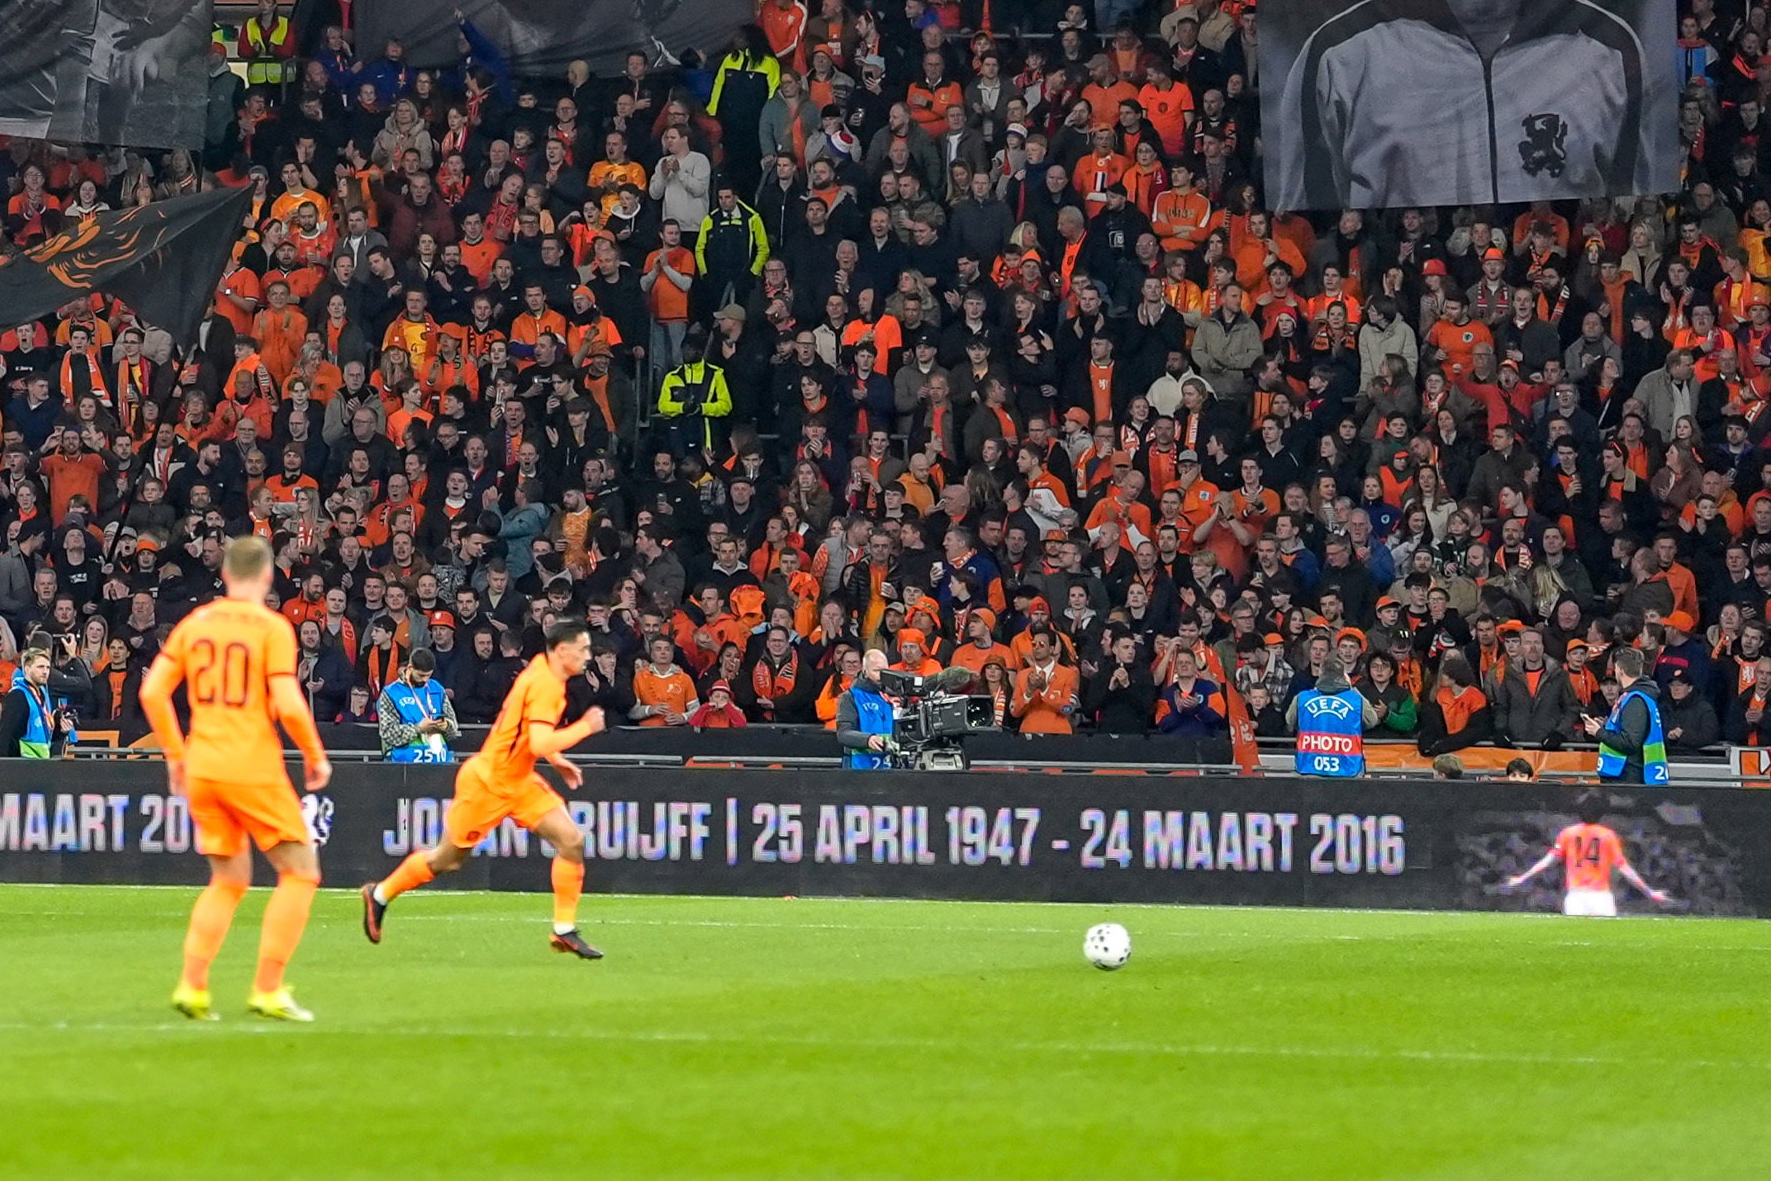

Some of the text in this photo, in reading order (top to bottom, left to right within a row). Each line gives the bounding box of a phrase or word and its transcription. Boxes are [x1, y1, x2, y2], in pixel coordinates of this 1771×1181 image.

[190, 638, 251, 707] 20
[1306, 698, 1352, 720] UEFA
[1301, 734, 1353, 753] PHOTO
[1314, 757, 1340, 772] 053
[140, 794, 192, 854] 20
[752, 803, 804, 864] 25
[815, 804, 935, 866] APRIL
[945, 805, 1041, 867] 1947
[1080, 808, 1133, 869] 24
[1143, 810, 1298, 872] MAART
[1309, 812, 1405, 875] 2016
[1574, 835, 1601, 868] 14
